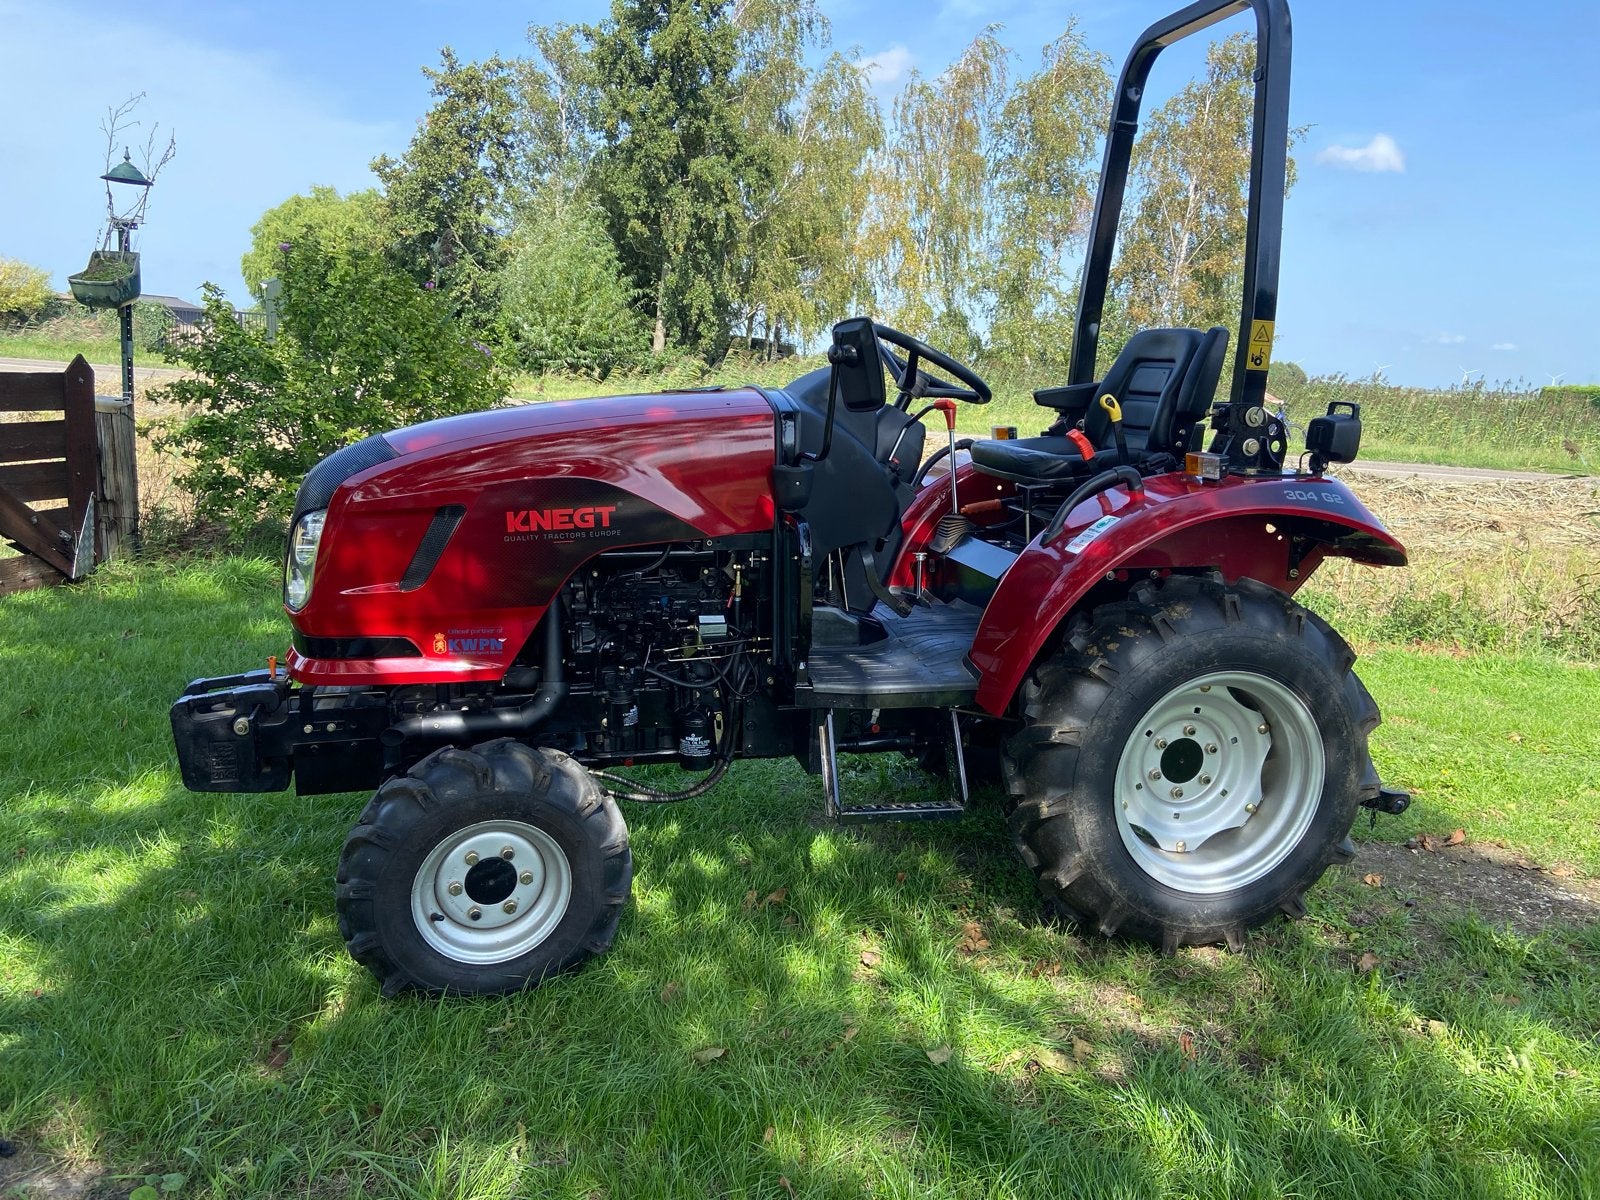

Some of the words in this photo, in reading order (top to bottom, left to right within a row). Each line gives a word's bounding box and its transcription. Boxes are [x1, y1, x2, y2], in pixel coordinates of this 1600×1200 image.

[1284, 490, 1318, 501] 304
[1321, 492, 1344, 504] G2
[506, 506, 616, 532] KNEGT
[503, 534, 539, 542] QUALITY
[543, 531, 586, 540] TRACTORS
[589, 529, 622, 538] EUROPE
[448, 638, 503, 651] KWPN
